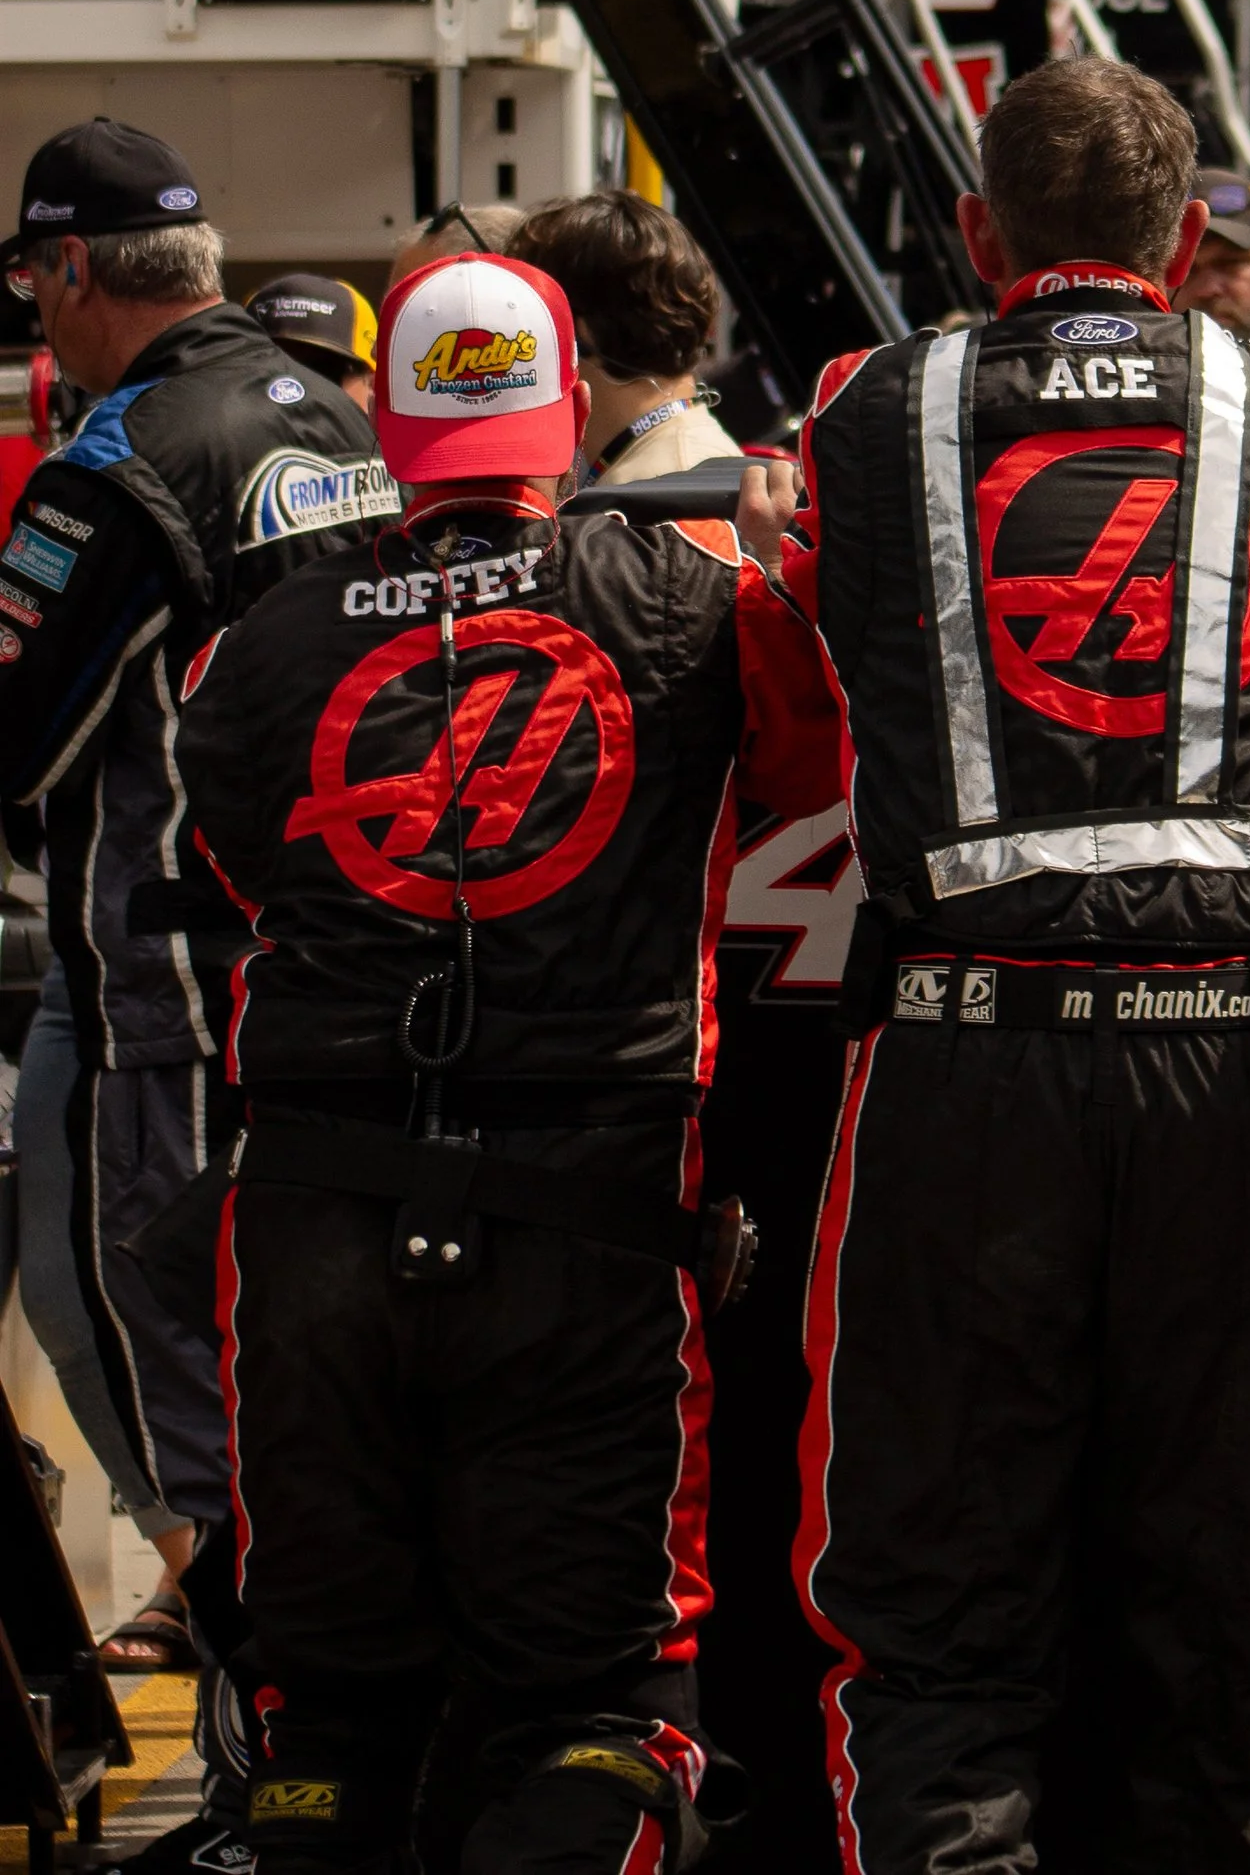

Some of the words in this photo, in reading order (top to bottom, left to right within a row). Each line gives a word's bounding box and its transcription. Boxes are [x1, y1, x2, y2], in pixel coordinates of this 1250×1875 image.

[413, 329, 538, 392] Andy's
[430, 377, 480, 395] Frozen
[483, 369, 537, 391] Custard
[1039, 357, 1158, 400] ACE
[630, 397, 683, 437] NASCAR
[36, 504, 95, 543] NASCAR
[343, 548, 543, 617] COFFEY
[722, 796, 865, 989] 4
